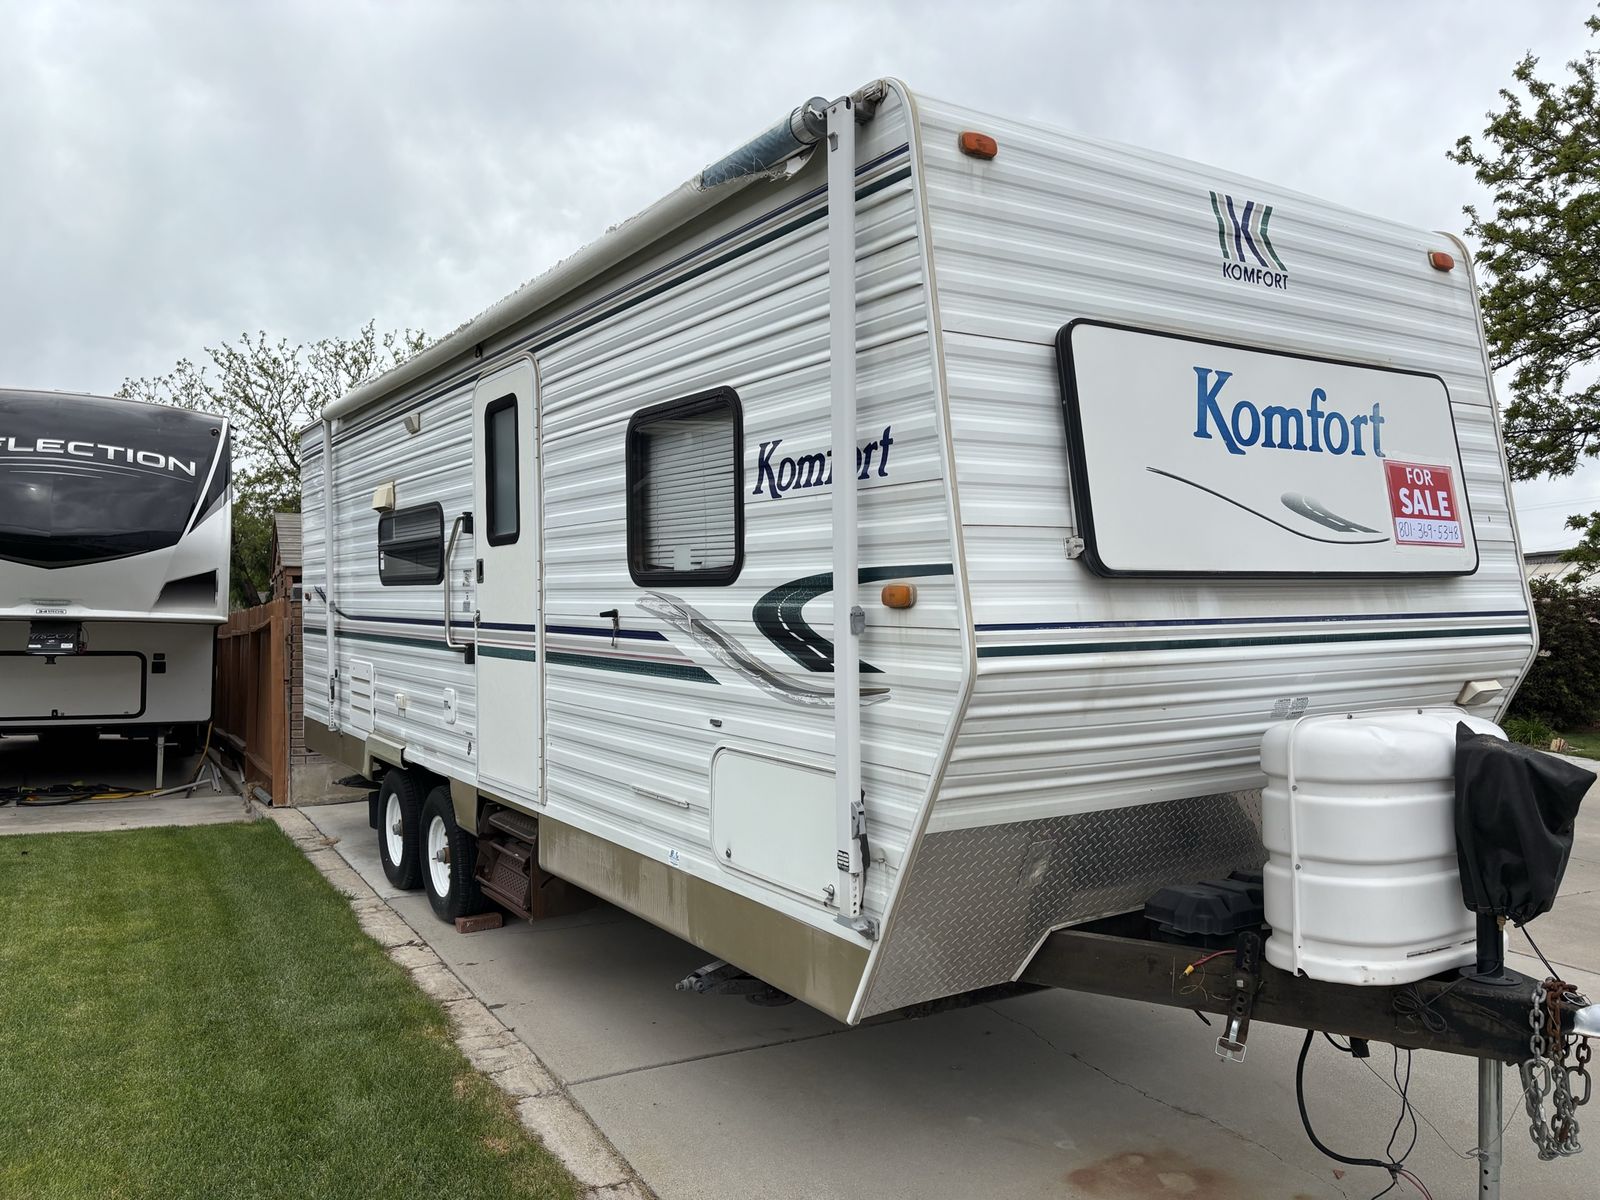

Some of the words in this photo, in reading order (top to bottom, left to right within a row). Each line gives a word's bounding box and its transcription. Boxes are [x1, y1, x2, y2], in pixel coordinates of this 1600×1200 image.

[1222, 261, 1289, 290] KOMFORT
[1192, 366, 1386, 458] Komfort
[0, 437, 196, 477] LECTION
[752, 425, 894, 499] Komrt
[1405, 467, 1434, 486] FOR
[1399, 487, 1452, 517] SALE
